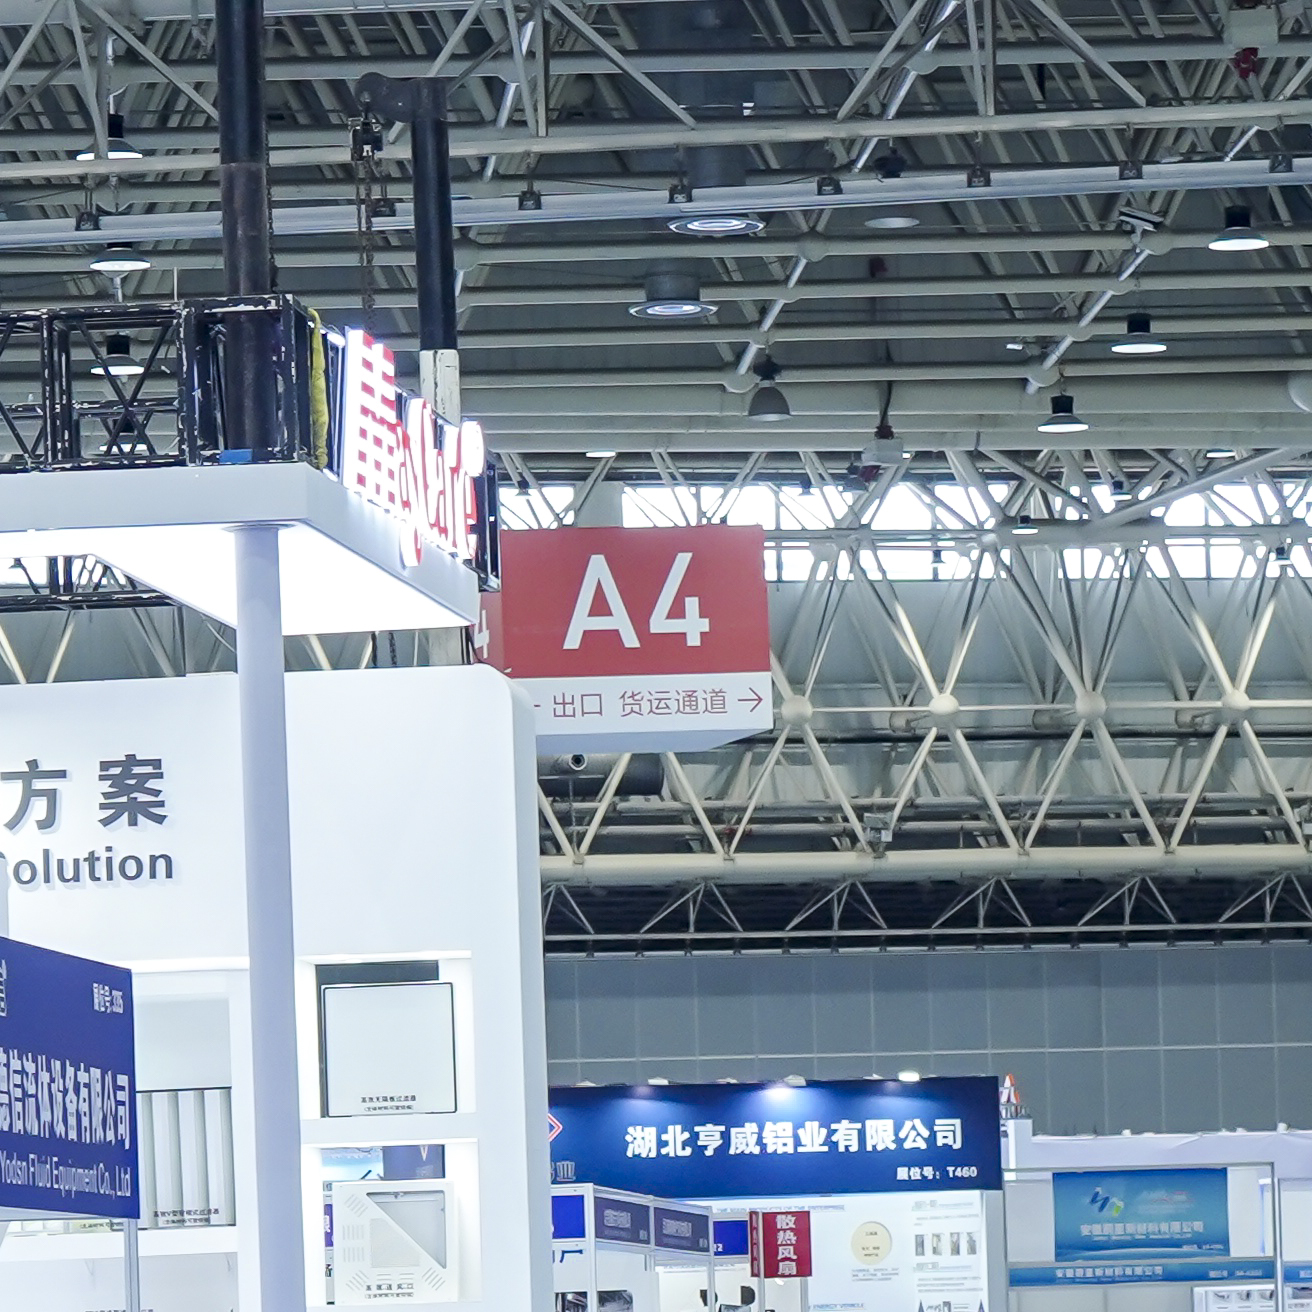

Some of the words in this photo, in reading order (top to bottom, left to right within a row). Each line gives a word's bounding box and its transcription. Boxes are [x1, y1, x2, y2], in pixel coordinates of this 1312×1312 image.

[563, 552, 709, 649] A4
[553, 692, 603, 718] 出口
[619, 688, 728, 718] 货运通道
[625, 1119, 962, 1158] 湖北亨威铝业有限公司
[0, 1150, 27, 1185] Yodsn
[29, 1153, 51, 1188] Fluid
[947, 1166, 977, 1179] T460
[776, 1214, 798, 1275] 散热风扇
